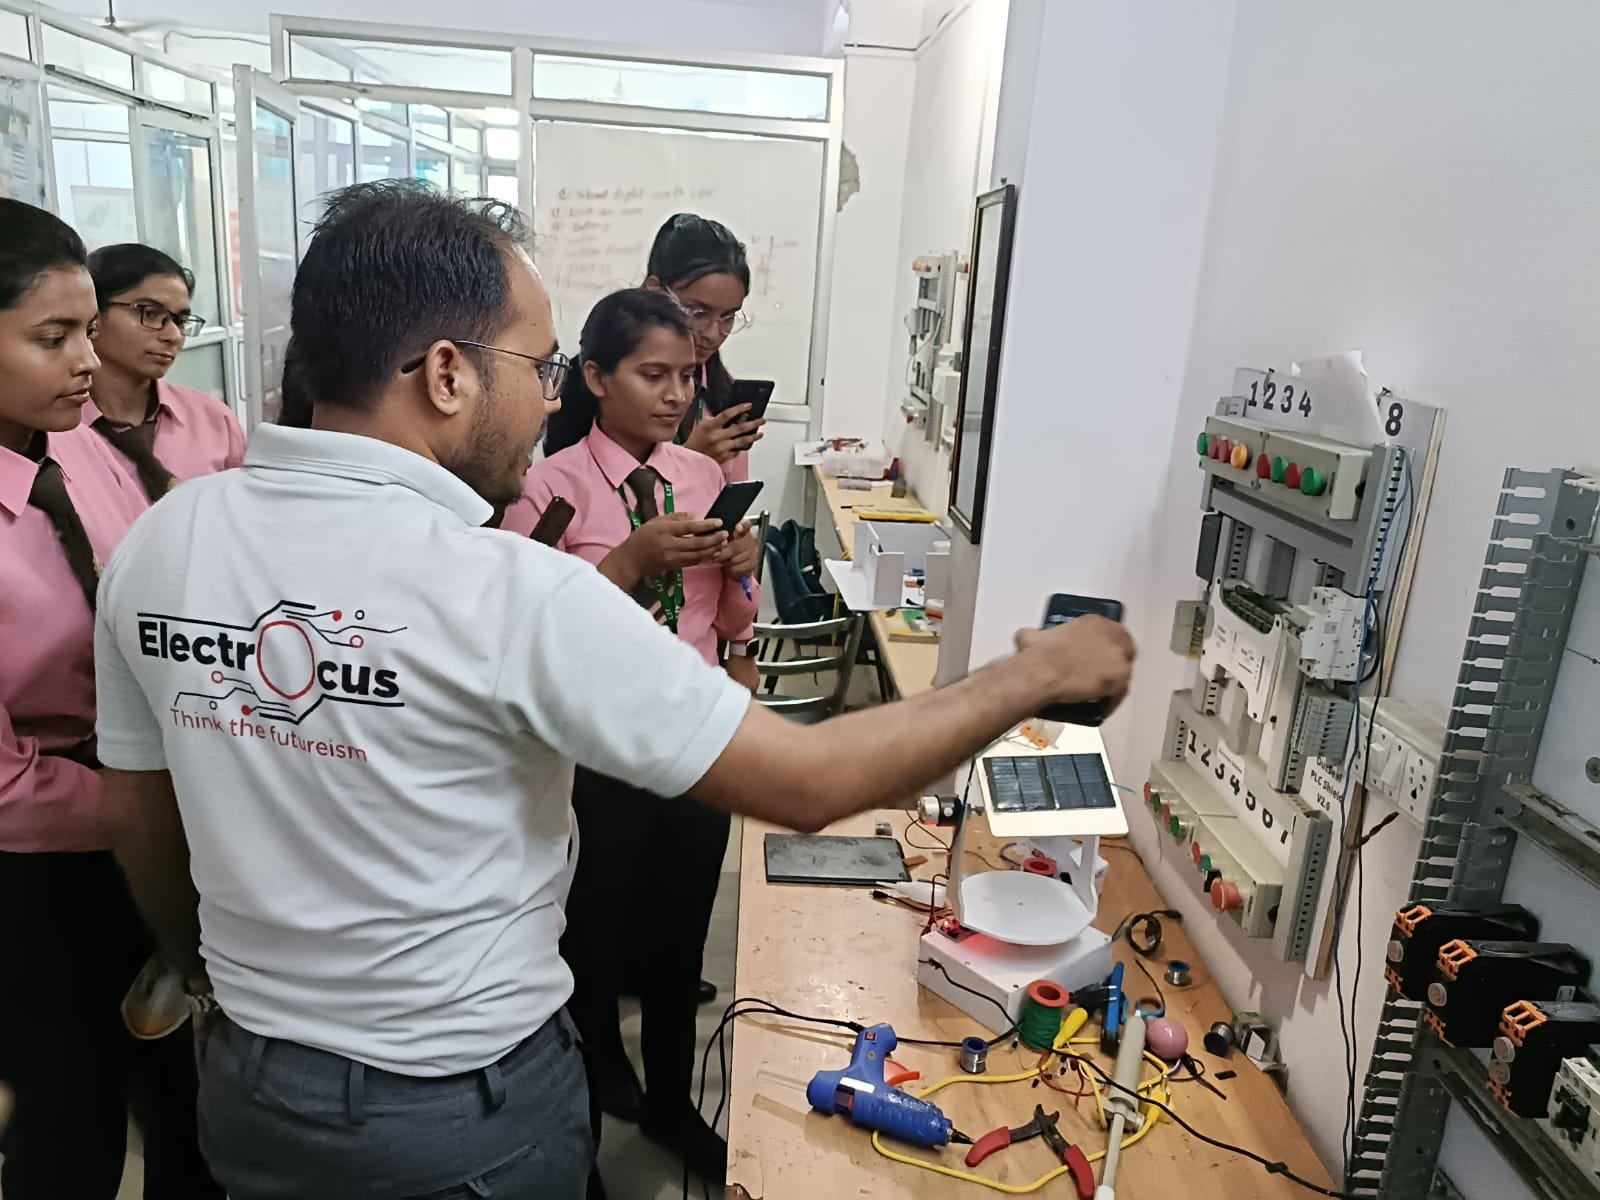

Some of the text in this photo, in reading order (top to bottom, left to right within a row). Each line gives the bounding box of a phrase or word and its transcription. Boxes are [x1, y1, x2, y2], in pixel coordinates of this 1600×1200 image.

[1385, 403, 1403, 436] 8
[170, 708, 368, 762] Think the futureism
[1311, 770, 1322, 786] PLC
